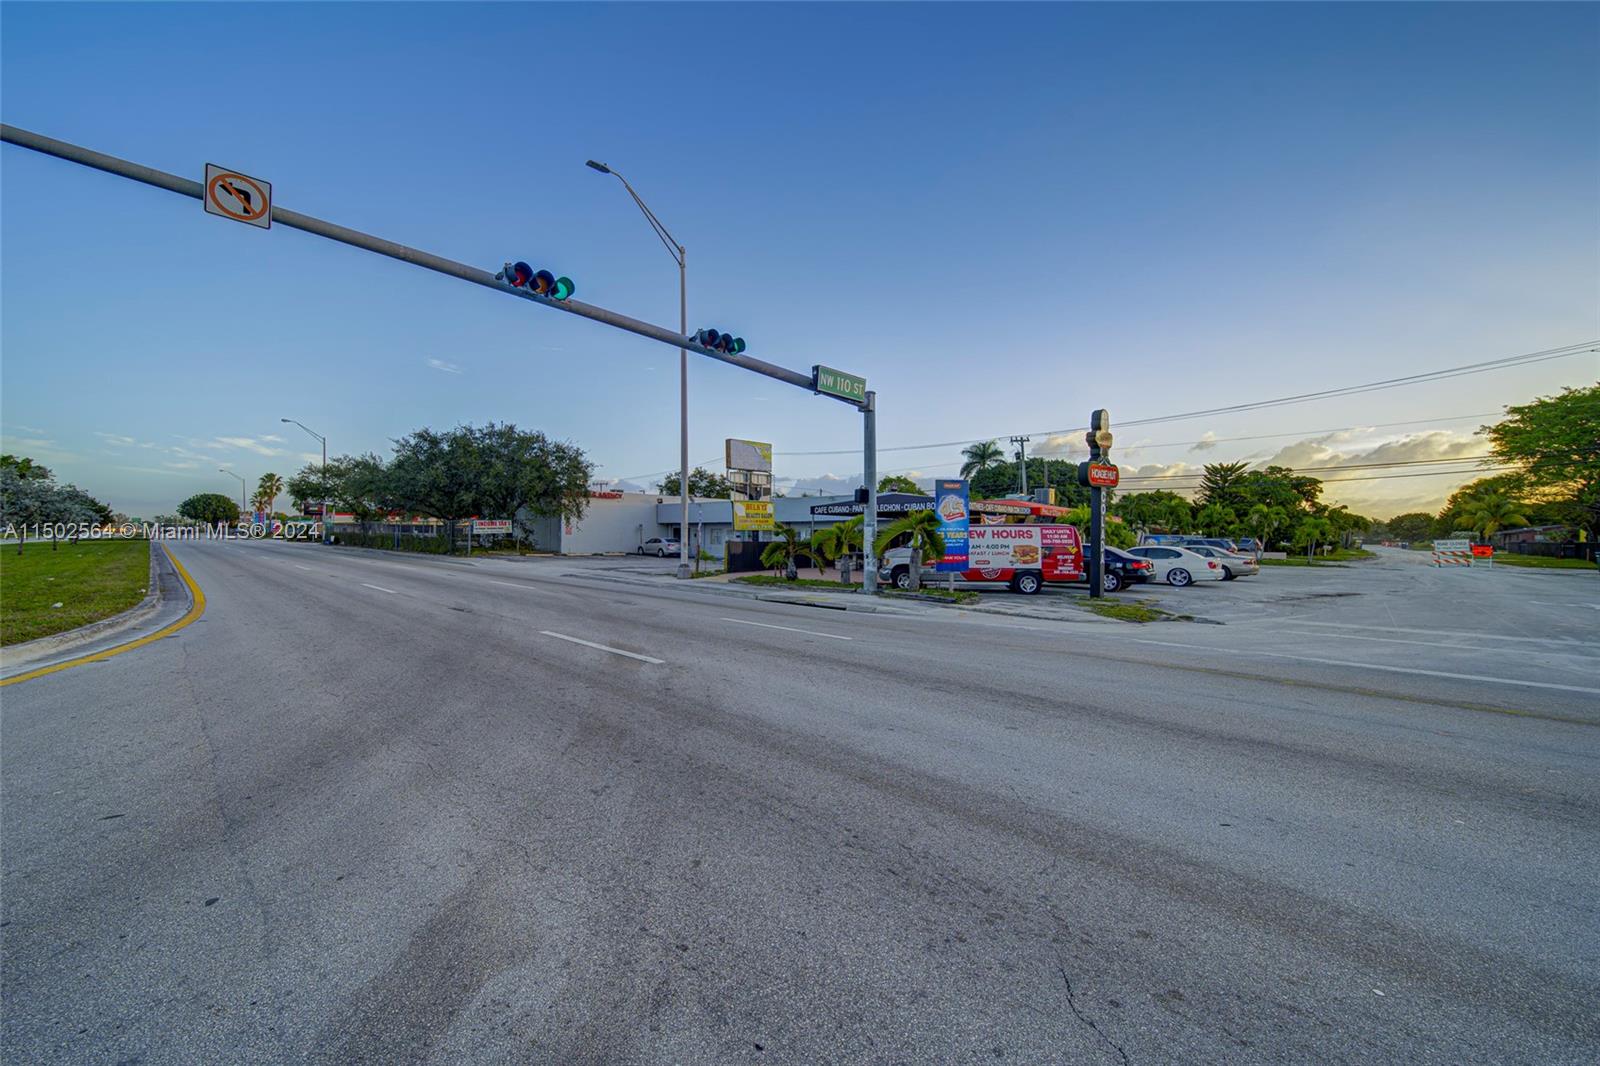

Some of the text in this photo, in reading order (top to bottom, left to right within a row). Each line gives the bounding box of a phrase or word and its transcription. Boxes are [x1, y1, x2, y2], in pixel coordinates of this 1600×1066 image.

[820, 373, 863, 395] NW 110 ST
[814, 506, 828, 514] CAFE
[828, 505, 850, 513] CUBANO
[877, 503, 901, 512] LECHON
[904, 502, 925, 511] CUBAN
[969, 530, 1033, 539] EW HOURS
